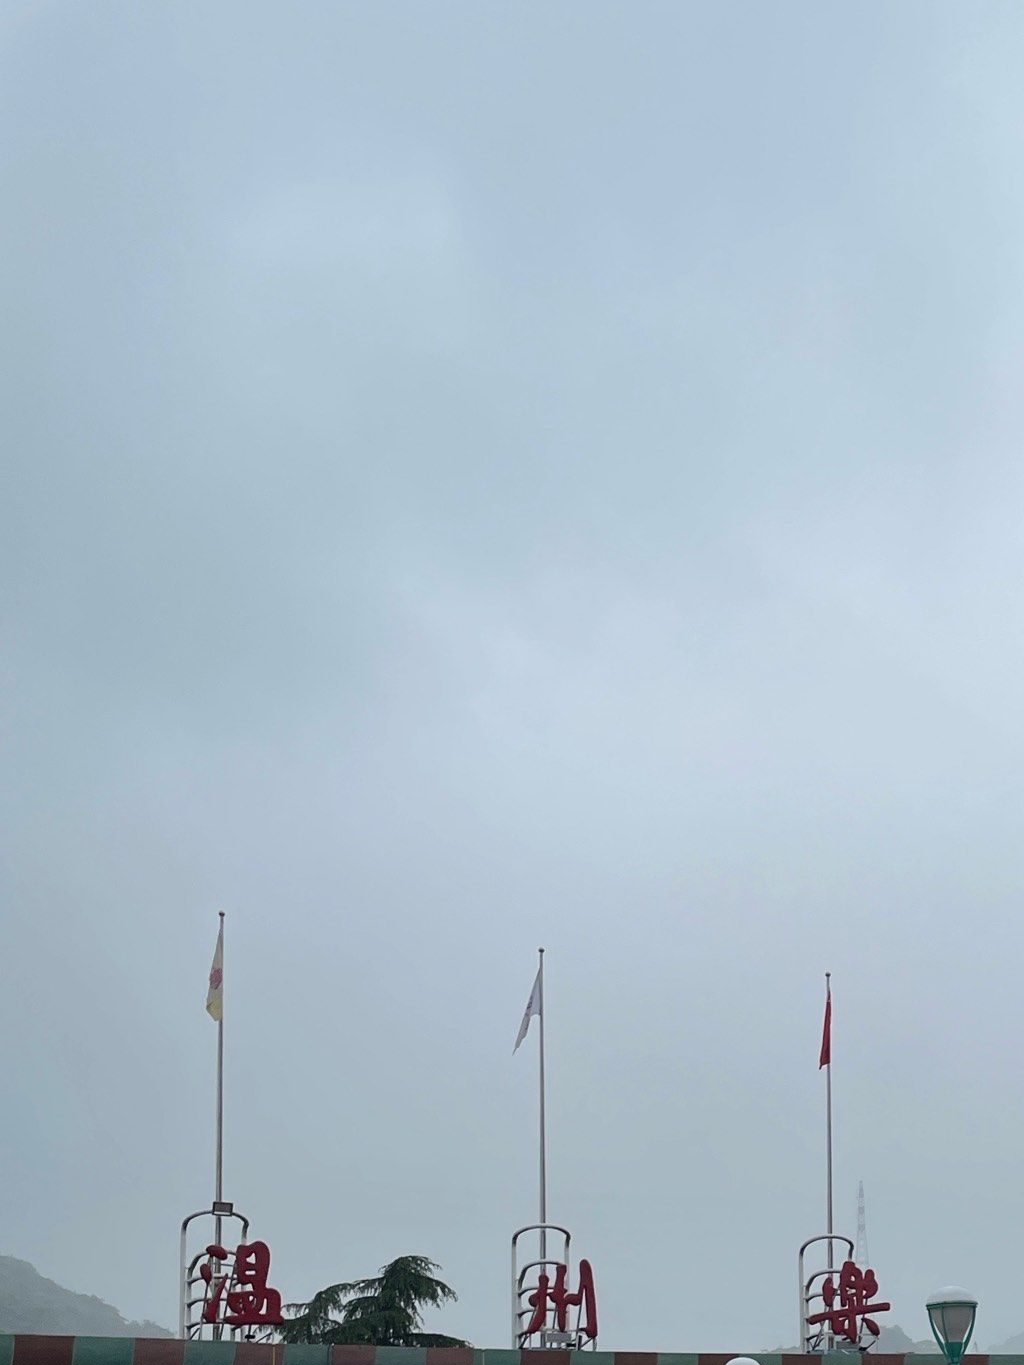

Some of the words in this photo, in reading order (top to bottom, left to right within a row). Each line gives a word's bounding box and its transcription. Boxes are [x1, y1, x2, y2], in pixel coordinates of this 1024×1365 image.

[200, 1241, 285, 1325] 温
[527, 1259, 598, 1338] 州
[807, 1261, 891, 1344] 樂
